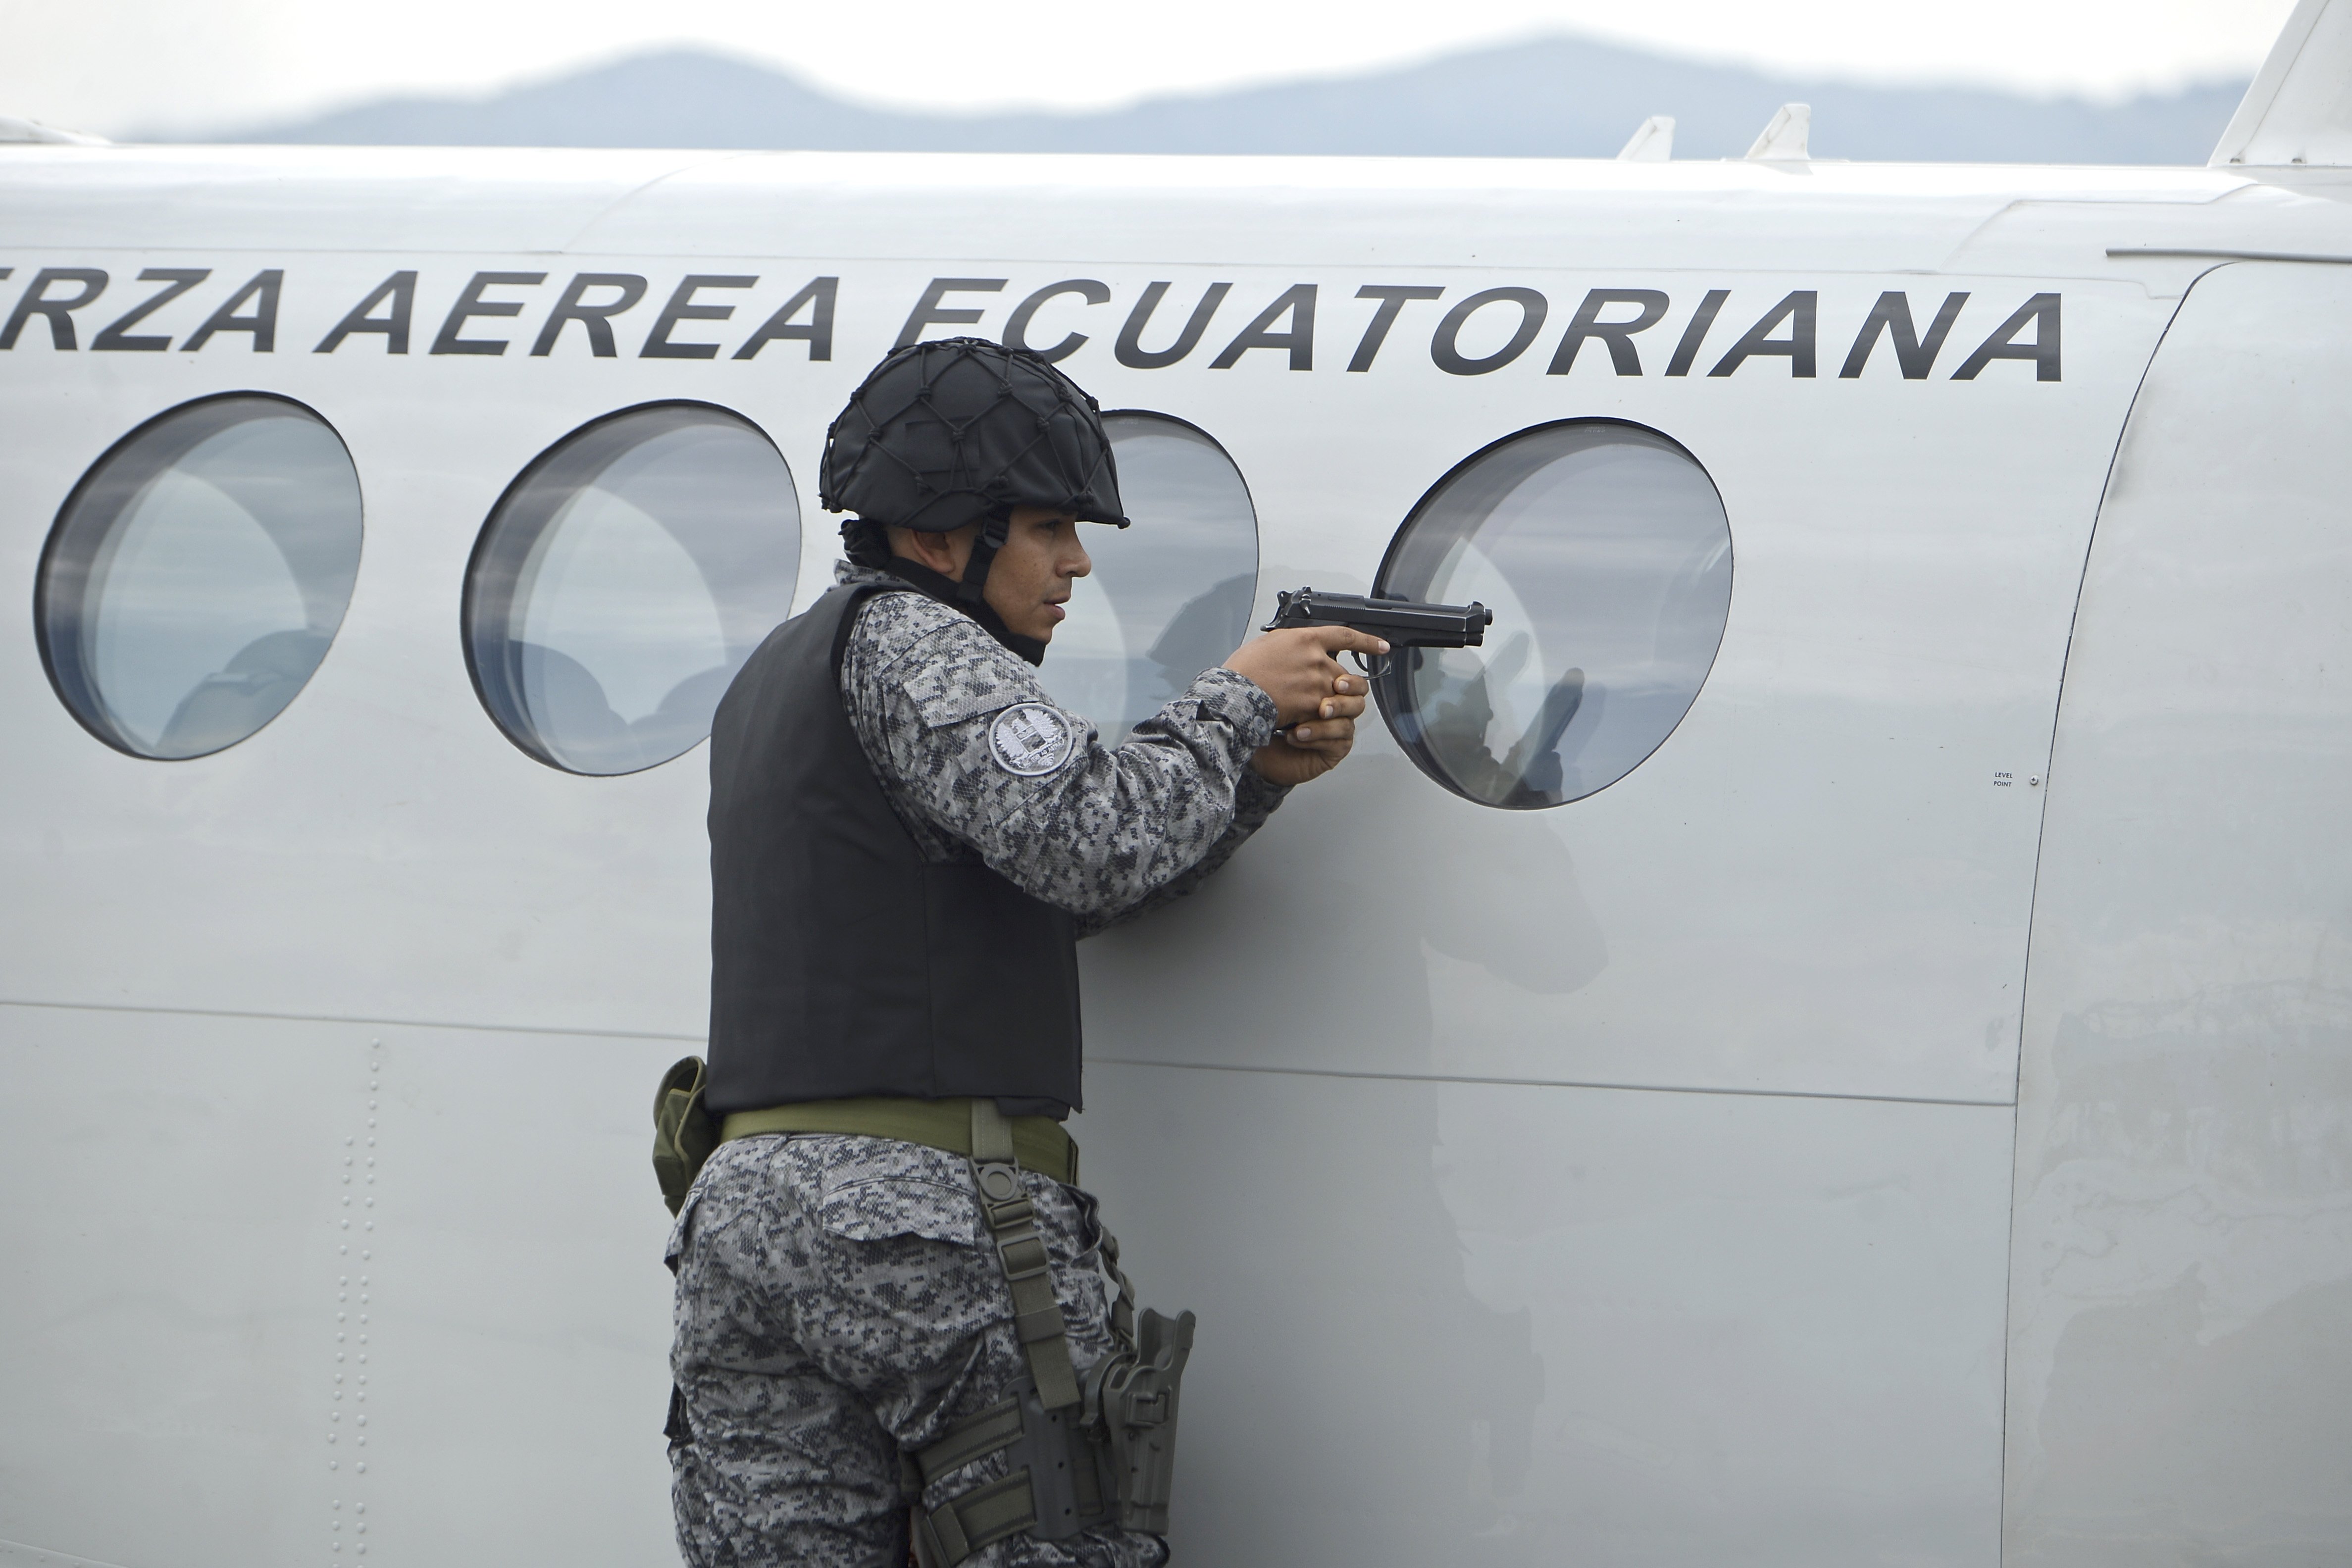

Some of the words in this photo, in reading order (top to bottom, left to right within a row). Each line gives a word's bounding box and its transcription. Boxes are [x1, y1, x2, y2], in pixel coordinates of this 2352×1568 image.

[0, 267, 285, 353] RZA
[311, 270, 839, 361] AEREA
[891, 277, 2061, 382] ECUATORIANA
